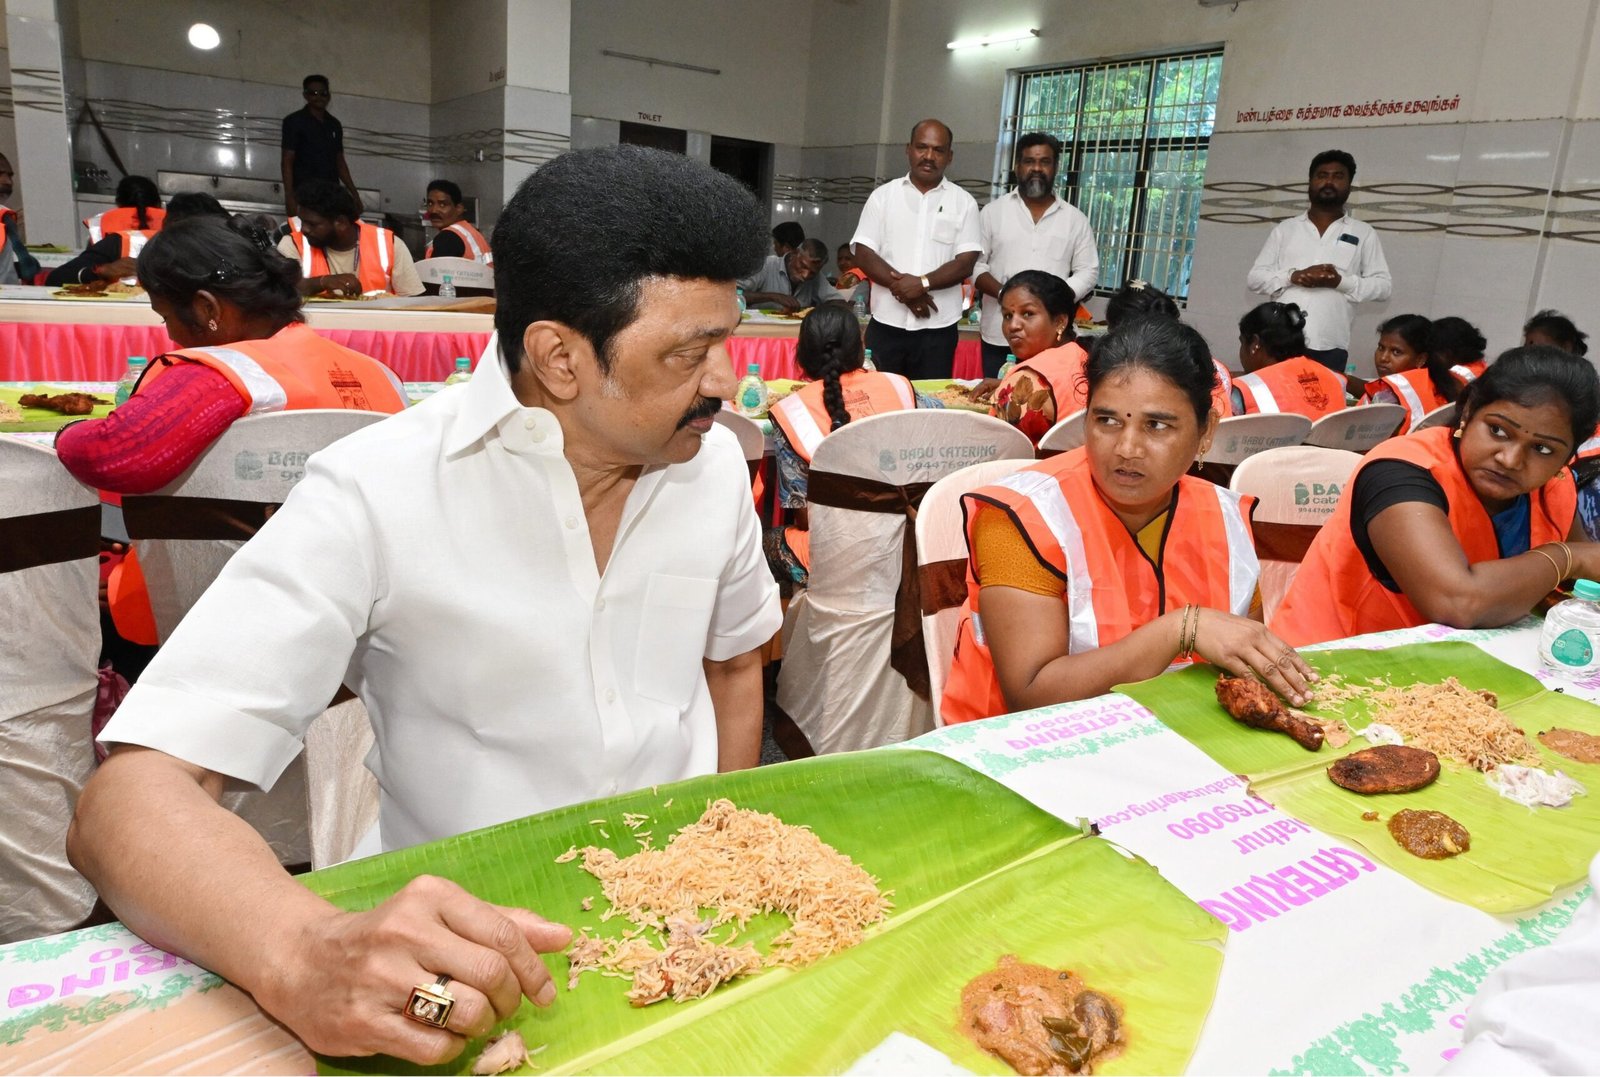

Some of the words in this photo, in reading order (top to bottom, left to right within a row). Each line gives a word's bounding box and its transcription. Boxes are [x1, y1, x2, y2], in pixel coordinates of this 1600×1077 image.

[637, 111, 663, 122] TOILET
[939, 445, 997, 458] CATERING
[1313, 483, 1346, 495] BA
[1006, 712, 1132, 750] CATERING
[1232, 818, 1311, 855] lathur
[1197, 846, 1378, 932] CATERING
[8, 952, 195, 1008] RING
